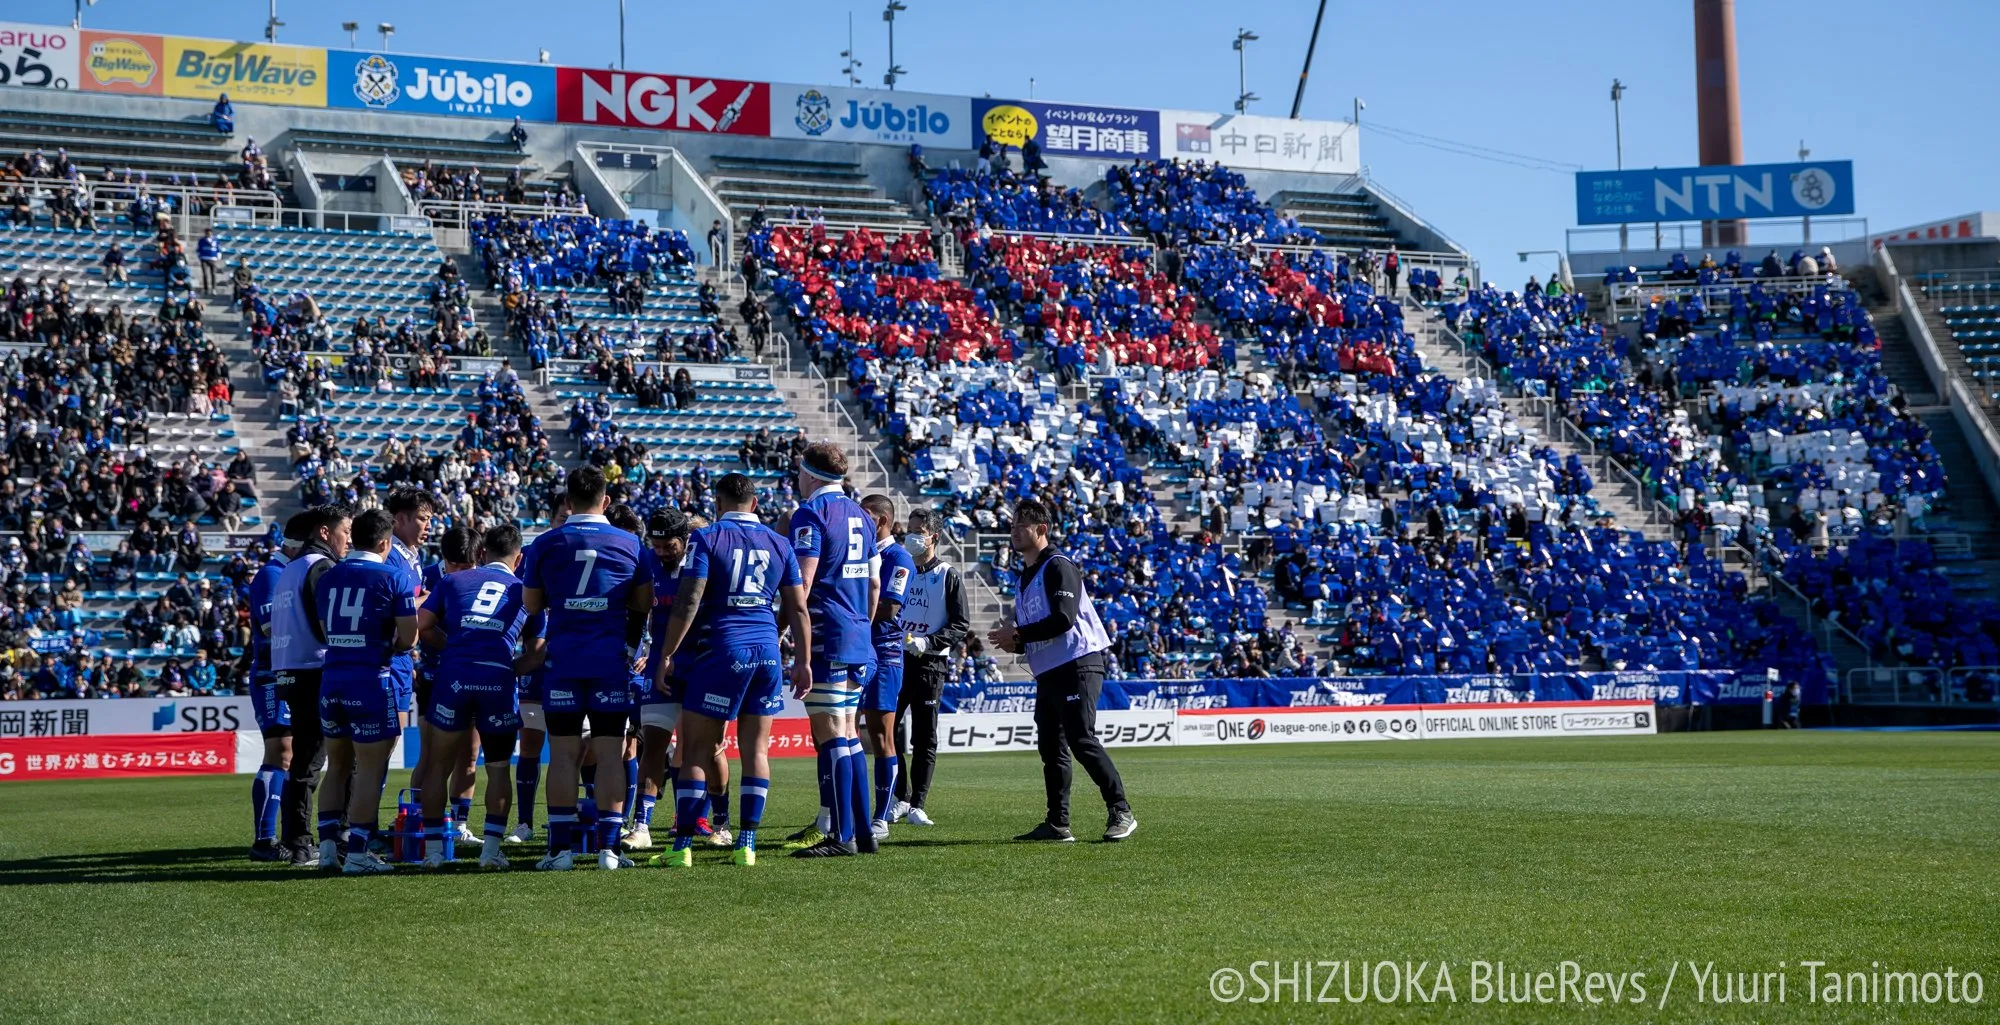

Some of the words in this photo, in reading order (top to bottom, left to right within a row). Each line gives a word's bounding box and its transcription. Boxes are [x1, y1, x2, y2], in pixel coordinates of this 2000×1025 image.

[92, 56, 152, 71] BigWave
[176, 49, 317, 86] BigWave
[237, 84, 295, 96] ビッグウェーブ
[406, 68, 533, 107] Júbilo
[449, 103, 492, 114] IWATA
[582, 71, 718, 132] NGK
[840, 100, 950, 135] Júbilo
[987, 113, 1031, 126] イベントの
[1044, 109, 1139, 125] イベントの安心ブランド
[877, 132, 915, 141] IWATA
[1045, 124, 1150, 154] 望月商事
[1220, 127, 1343, 162] 中日新聞
[623, 153, 632, 164] E
[1654, 173, 1774, 217] NTN
[848, 517, 864, 560] 5
[574, 549, 598, 595] 7
[729, 549, 770, 593] 13
[471, 581, 507, 615] 9
[327, 587, 366, 632] 14
[987, 685, 1037, 695] SHIZUOKA
[1157, 684, 1206, 695] SHIZUOKA
[957, 691, 1037, 713] BlueRe
[0, 708, 89, 737] 岡新聞
[181, 705, 240, 732] SBS
[1270, 722, 1341, 735] league-one.jp
[1425, 717, 1475, 732] OFFICIAL
[1479, 716, 1519, 731] ONLINE
[1522, 715, 1558, 730] STORE
[1566, 717, 1605, 727] リーグワン
[1607, 716, 1630, 726] グッズ
[1217, 719, 1245, 741] ONE
[26, 750, 227, 771] 世界が進むチカラになる。
